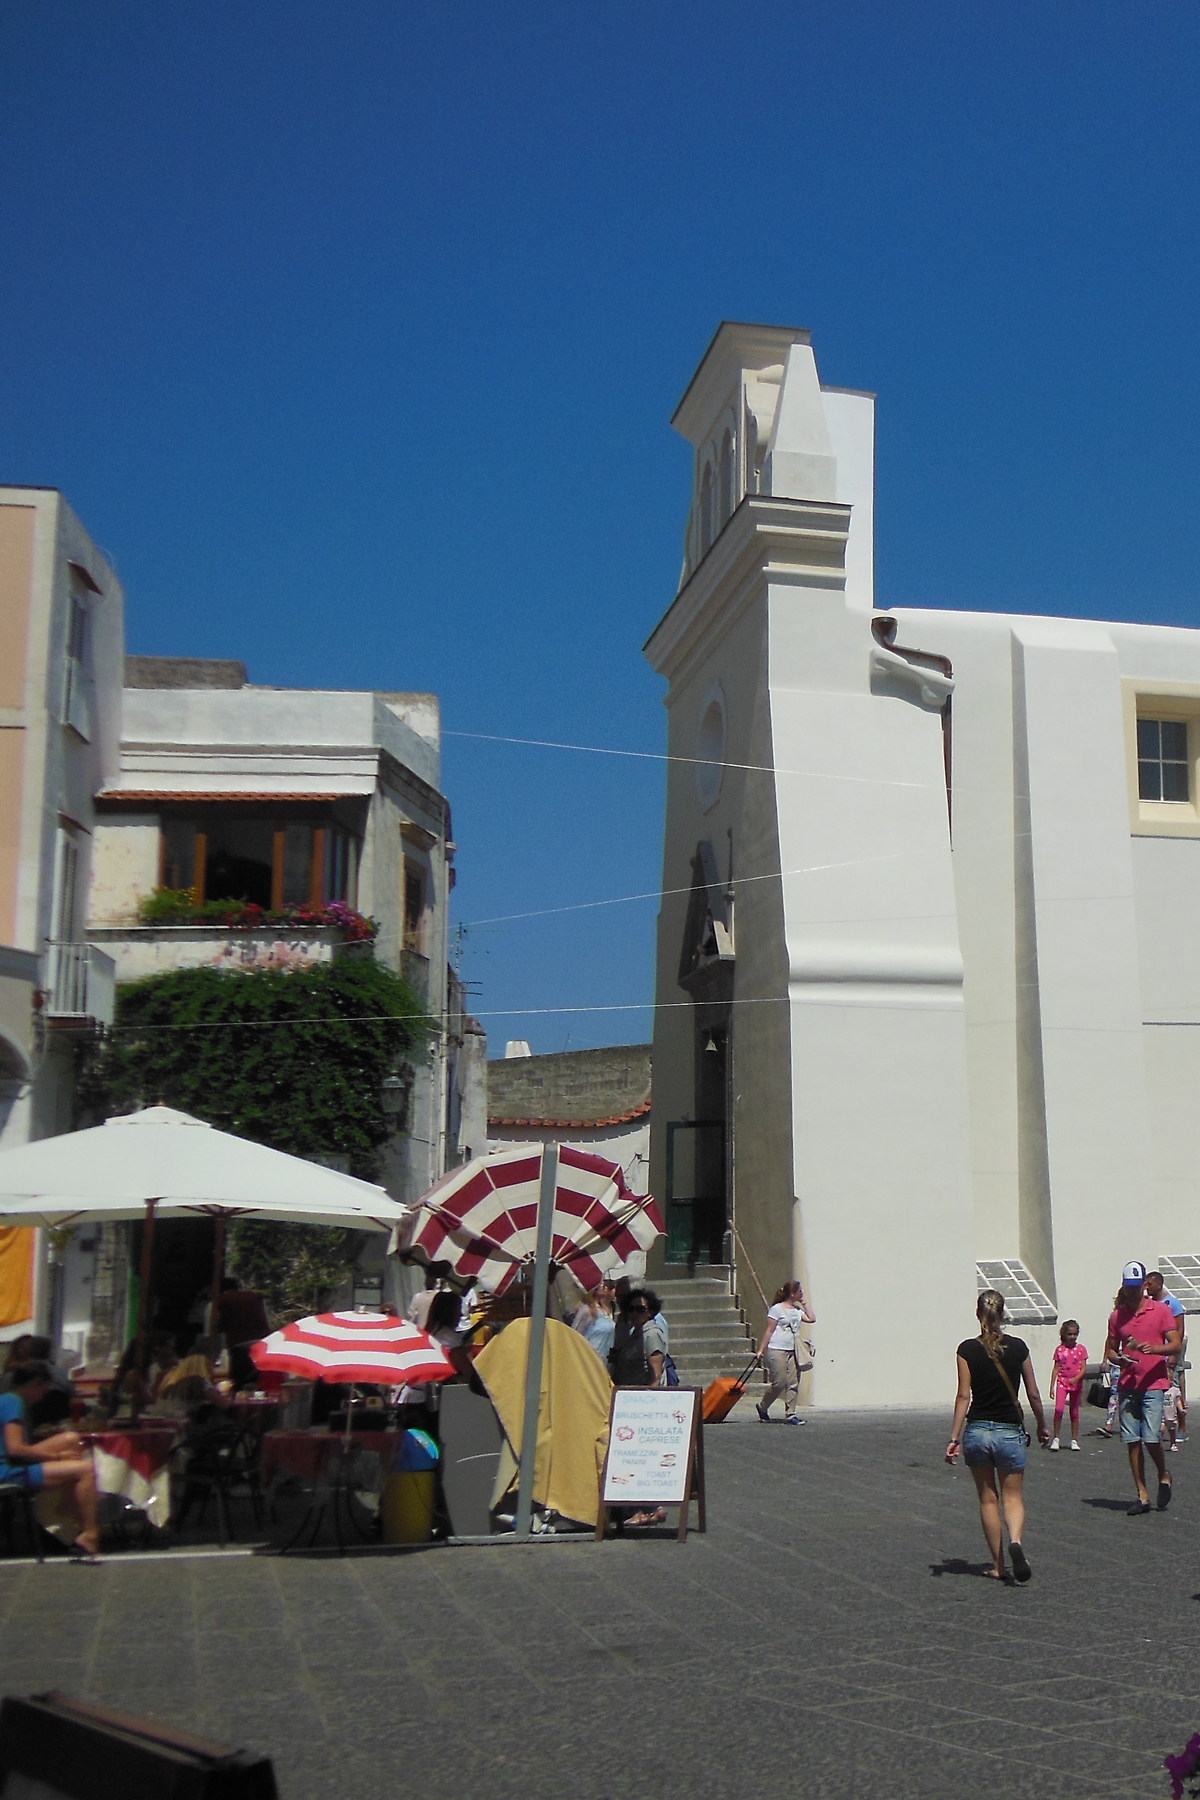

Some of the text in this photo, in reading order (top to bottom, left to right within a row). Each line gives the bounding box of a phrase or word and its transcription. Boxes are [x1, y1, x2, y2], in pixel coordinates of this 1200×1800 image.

[615, 1412, 669, 1420] BRUSCHETTA
[638, 1427, 683, 1435] INSALATA
[639, 1436, 681, 1444] CAPRESE
